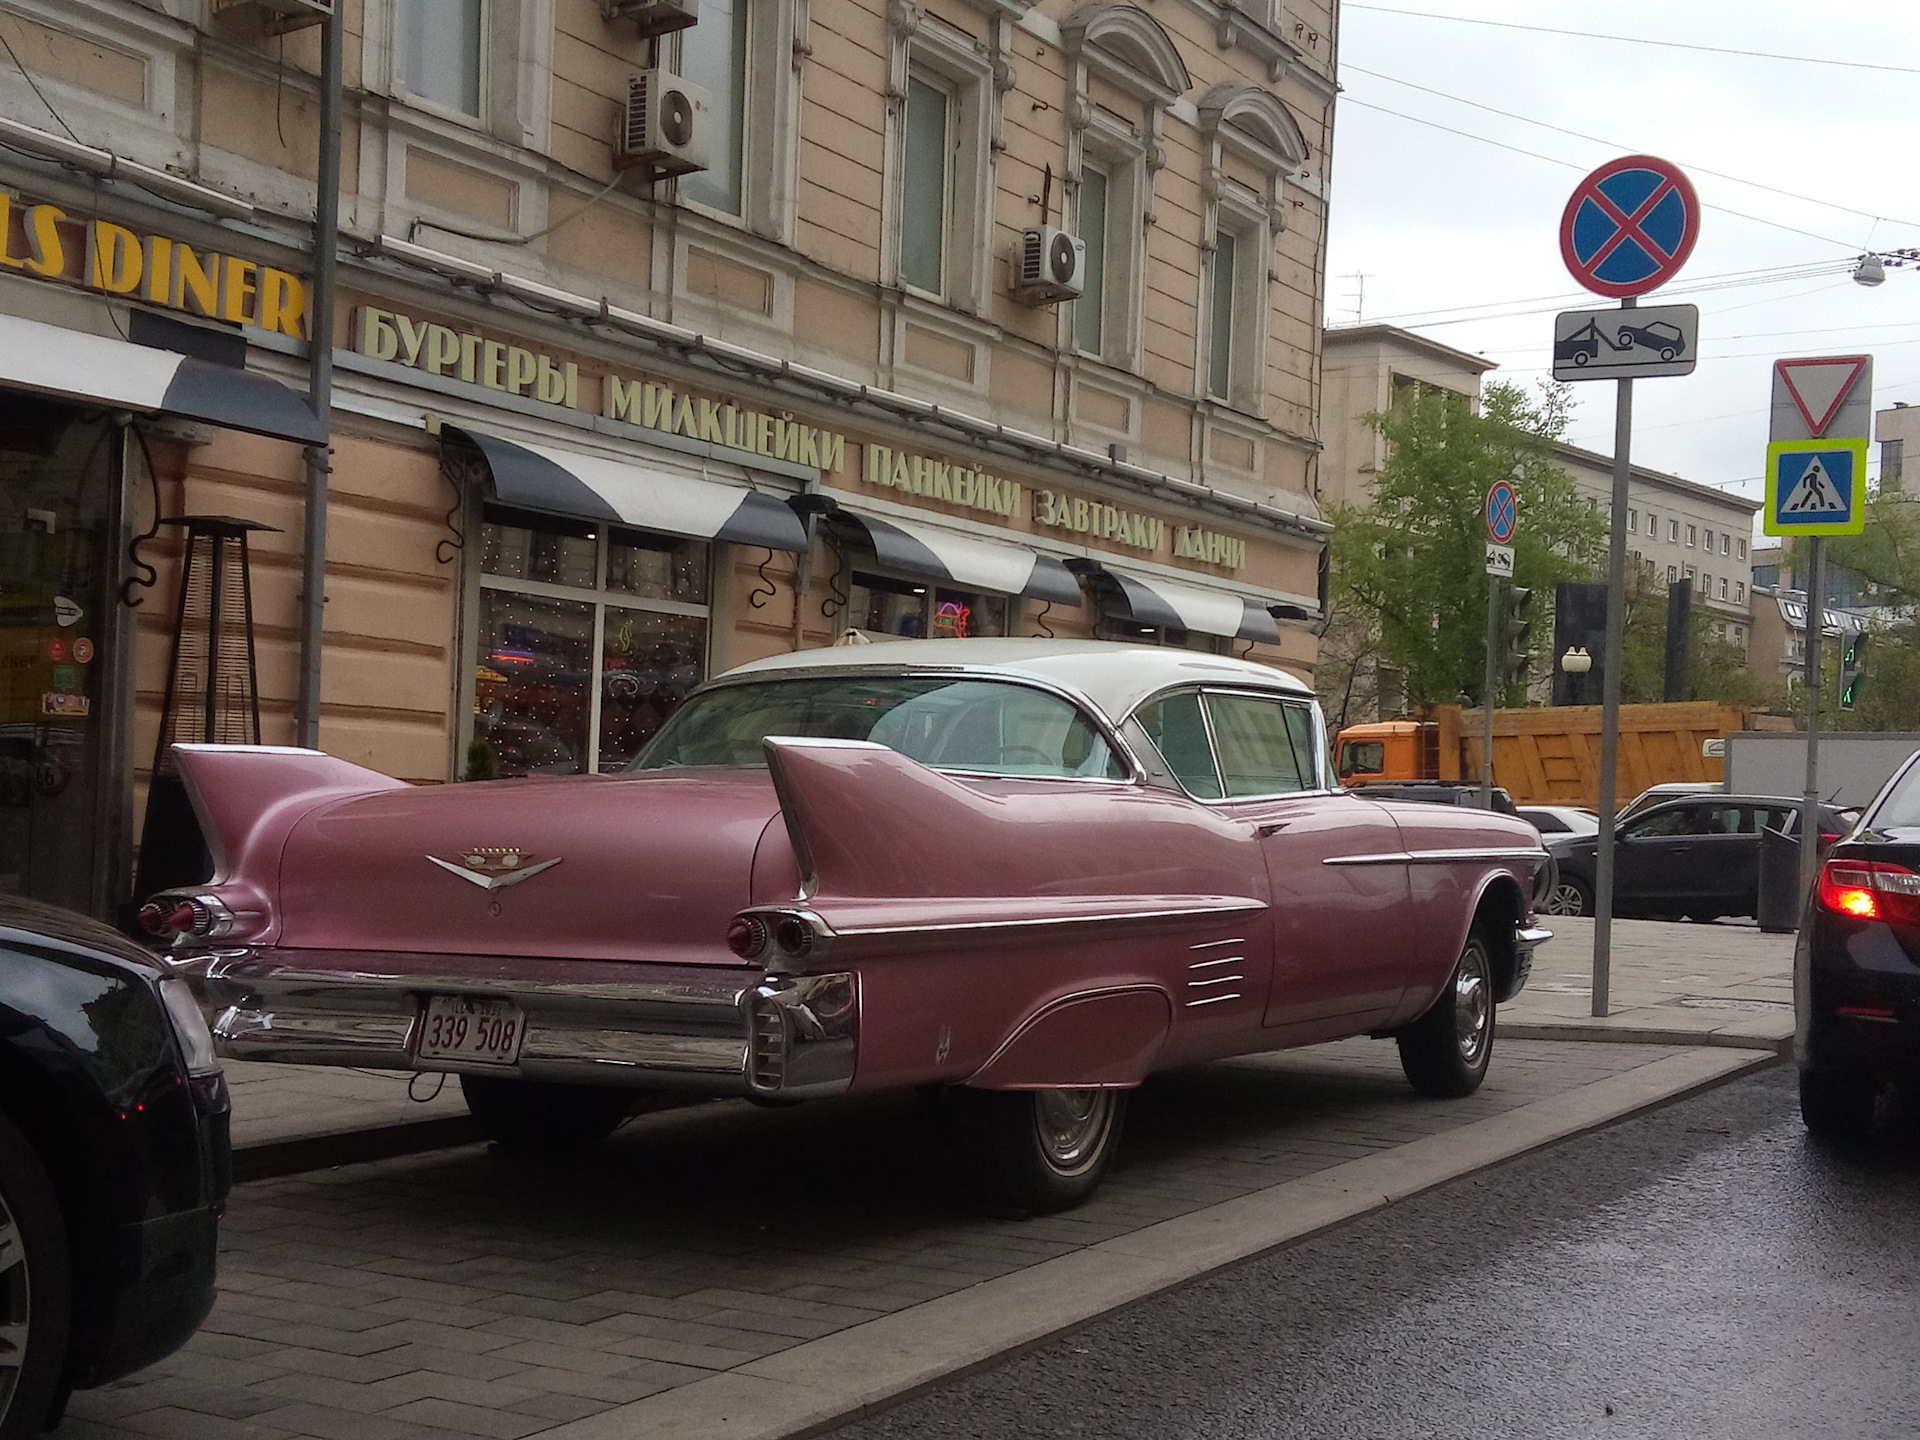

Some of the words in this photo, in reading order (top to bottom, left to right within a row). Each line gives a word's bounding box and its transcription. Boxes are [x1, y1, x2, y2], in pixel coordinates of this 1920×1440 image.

[92, 219, 304, 338] DINER
[363, 305, 579, 408] БУРГЕРЫ
[610, 374, 845, 473] МИЛКШЕЙКИ
[869, 443, 1021, 518] ПАНКЕЙКИ
[1035, 489, 1165, 551] ЗАВТРАКИ
[1174, 525, 1246, 569] ЛАНЧИ
[428, 1014, 468, 1049] 339
[475, 1017, 516, 1053] 508
